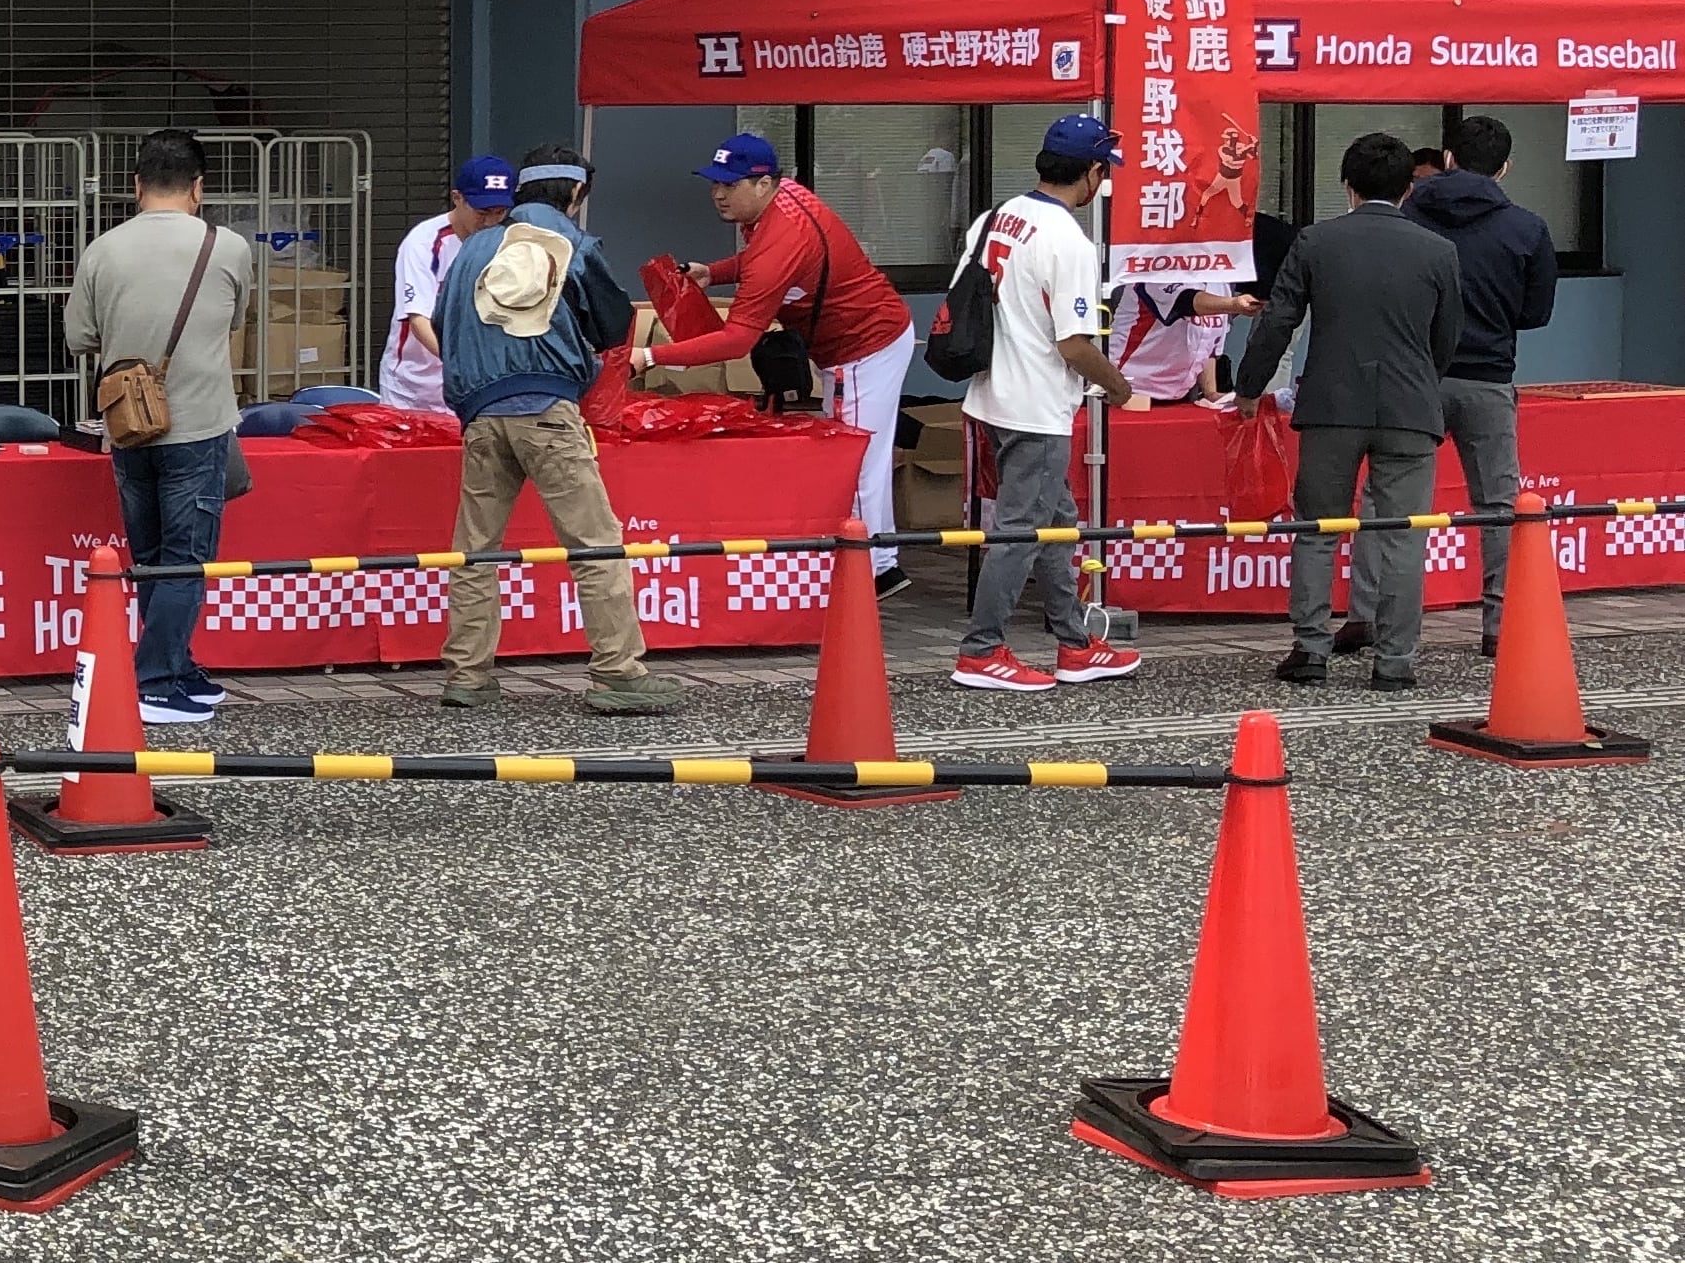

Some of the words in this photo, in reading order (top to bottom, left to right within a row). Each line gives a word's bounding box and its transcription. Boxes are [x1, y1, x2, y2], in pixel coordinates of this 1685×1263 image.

[697, 35, 744, 75] H
[900, 28, 1041, 68] 硬式野球部
[1316, 34, 1412, 66] Honda
[1430, 35, 1539, 68] Suzuka
[1557, 37, 1677, 71] Baseball
[485, 175, 508, 190] H
[1124, 253, 1236, 274] HONDA
[1538, 474, 1560, 488] Are
[627, 516, 658, 532] Are
[71, 534, 103, 549] We
[106, 533, 128, 548] Ar
[559, 576, 701, 634] Hda!
